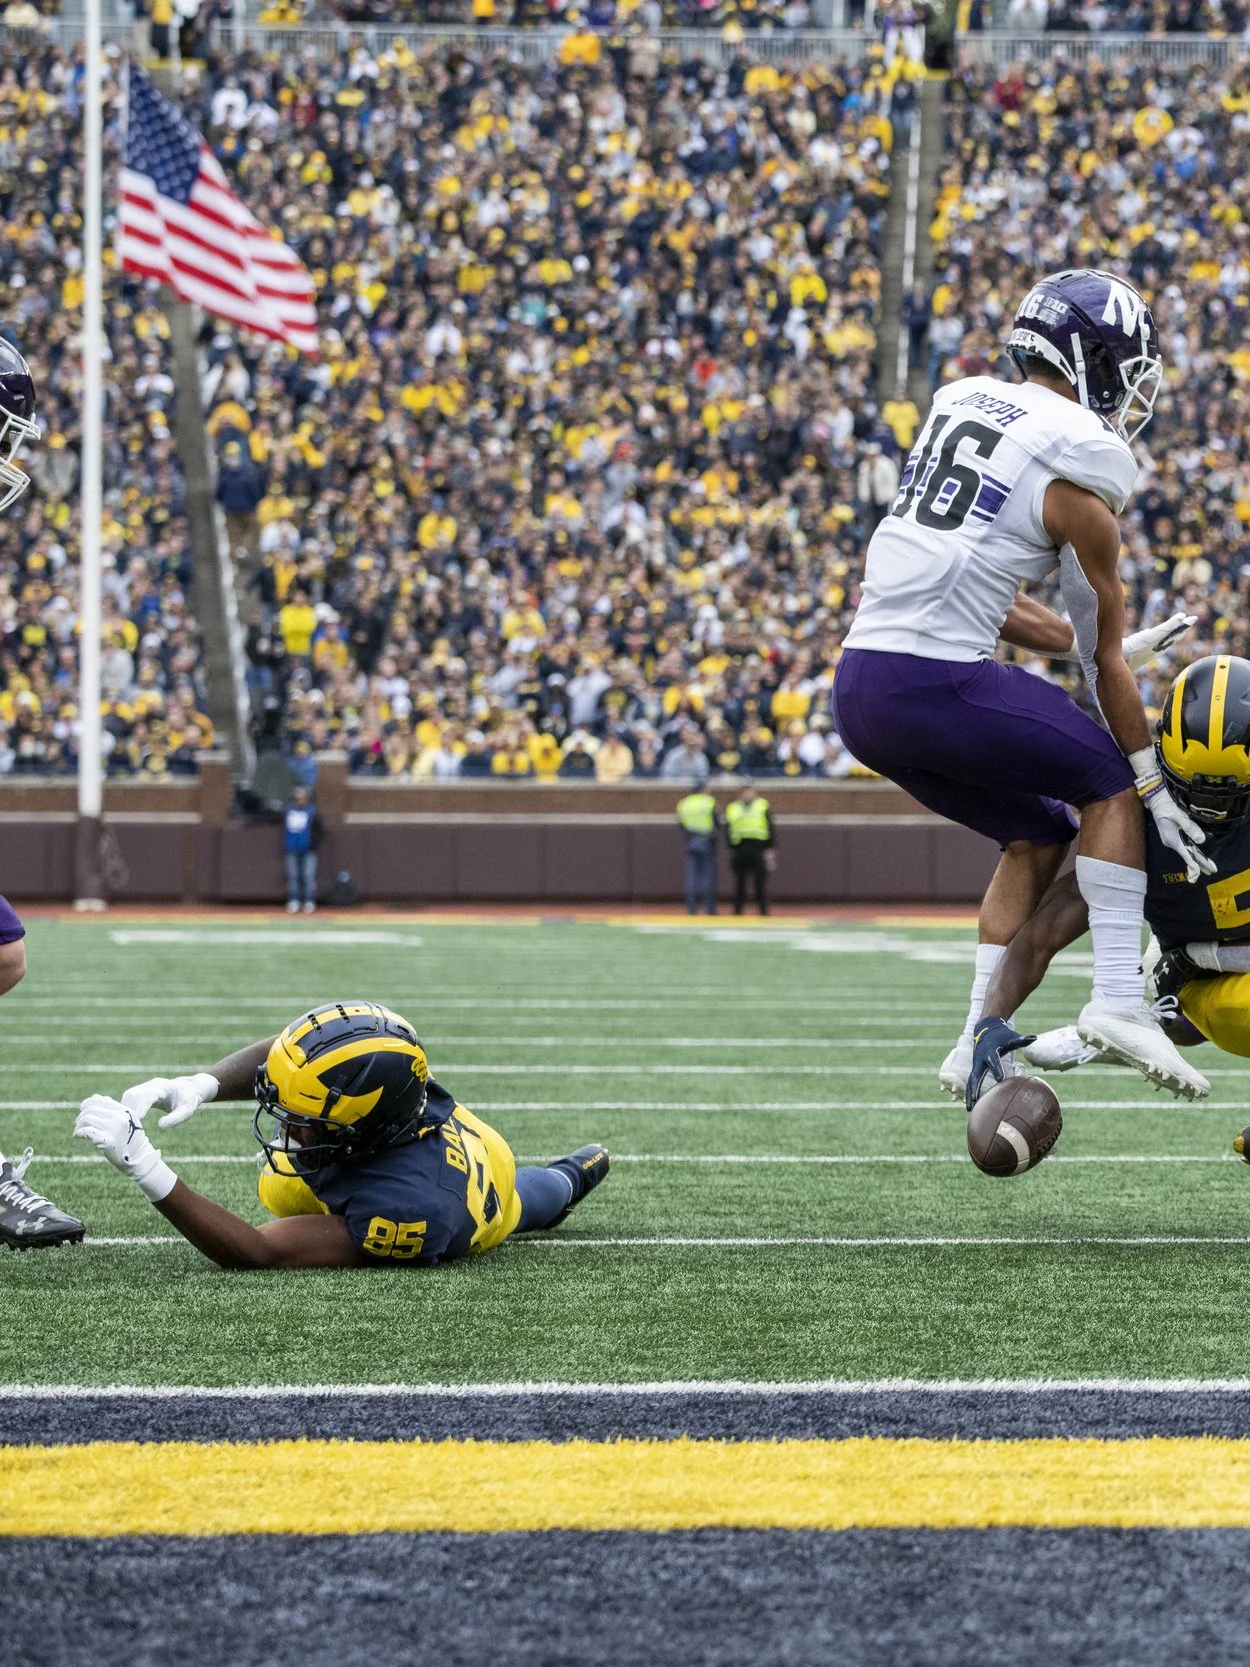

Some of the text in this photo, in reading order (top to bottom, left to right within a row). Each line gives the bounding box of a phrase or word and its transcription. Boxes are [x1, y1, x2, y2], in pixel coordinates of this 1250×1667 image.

[951, 391, 1028, 428] JOSEPH
[891, 414, 1004, 531] 16
[362, 1215, 428, 1259] 85
